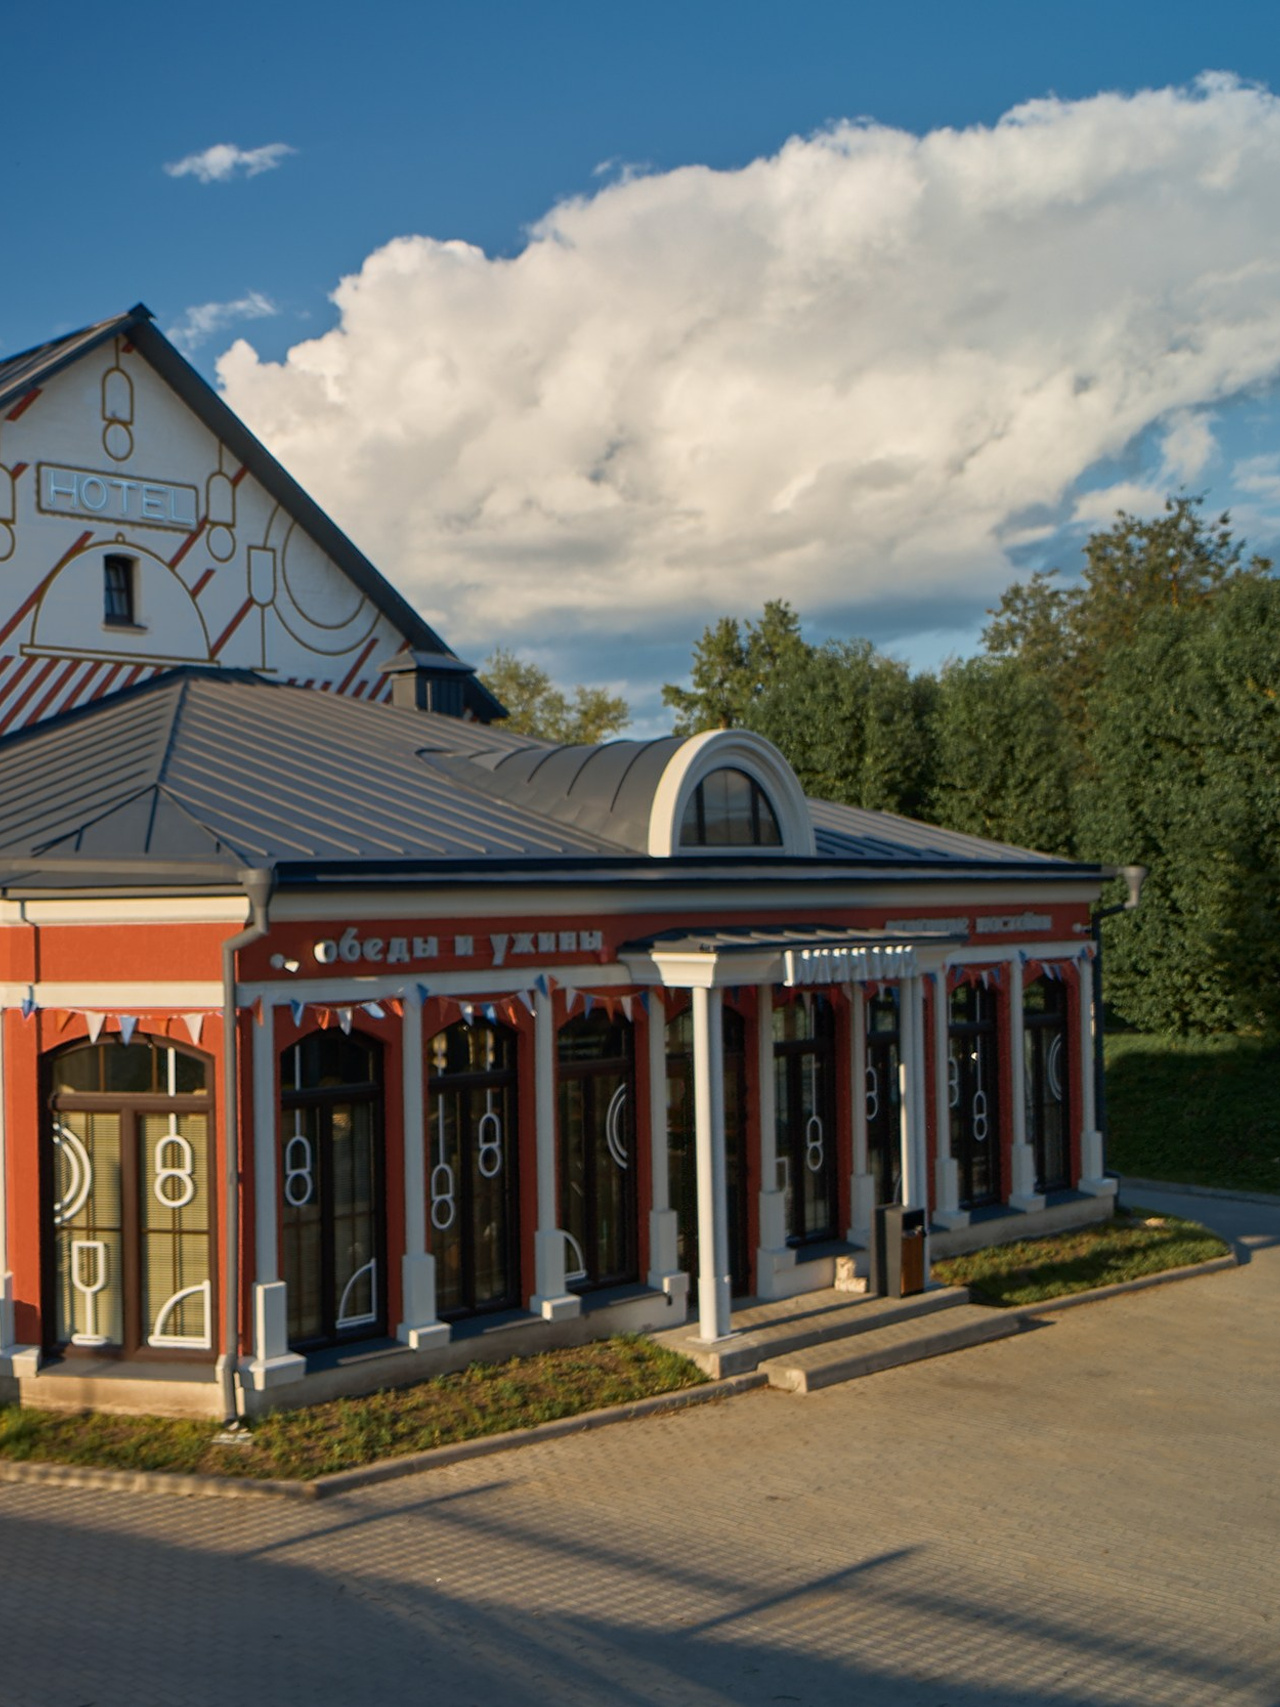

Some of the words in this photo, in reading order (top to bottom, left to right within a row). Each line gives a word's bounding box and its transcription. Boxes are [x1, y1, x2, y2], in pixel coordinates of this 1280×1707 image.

[48, 470, 195, 526] HOTEL
[314, 927, 438, 964] обеды
[454, 935, 474, 956] и
[489, 931, 602, 966] ужины
